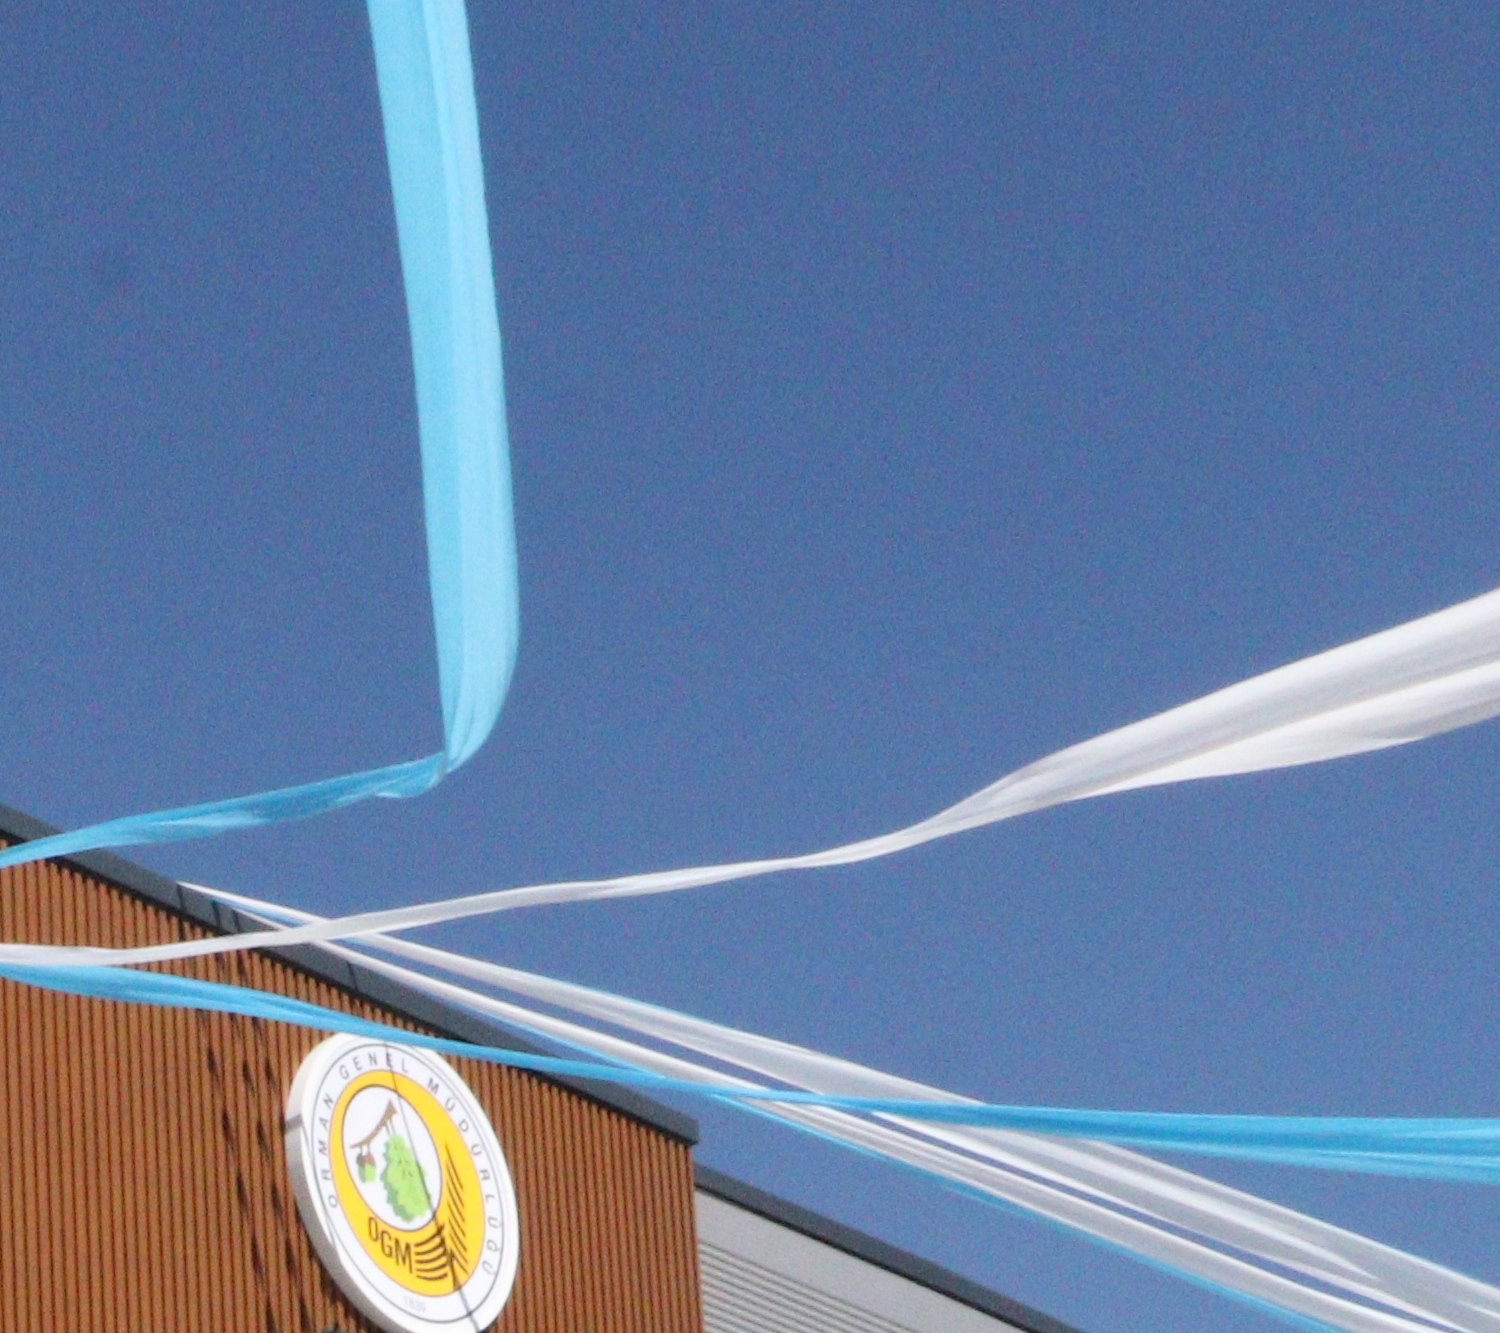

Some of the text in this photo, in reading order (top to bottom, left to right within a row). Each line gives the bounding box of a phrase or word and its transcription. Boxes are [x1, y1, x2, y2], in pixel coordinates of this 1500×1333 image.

[317, 1093, 339, 1208] ORMAN
[338, 1051, 409, 1080] GENEL
[368, 1216, 414, 1275] OGM
